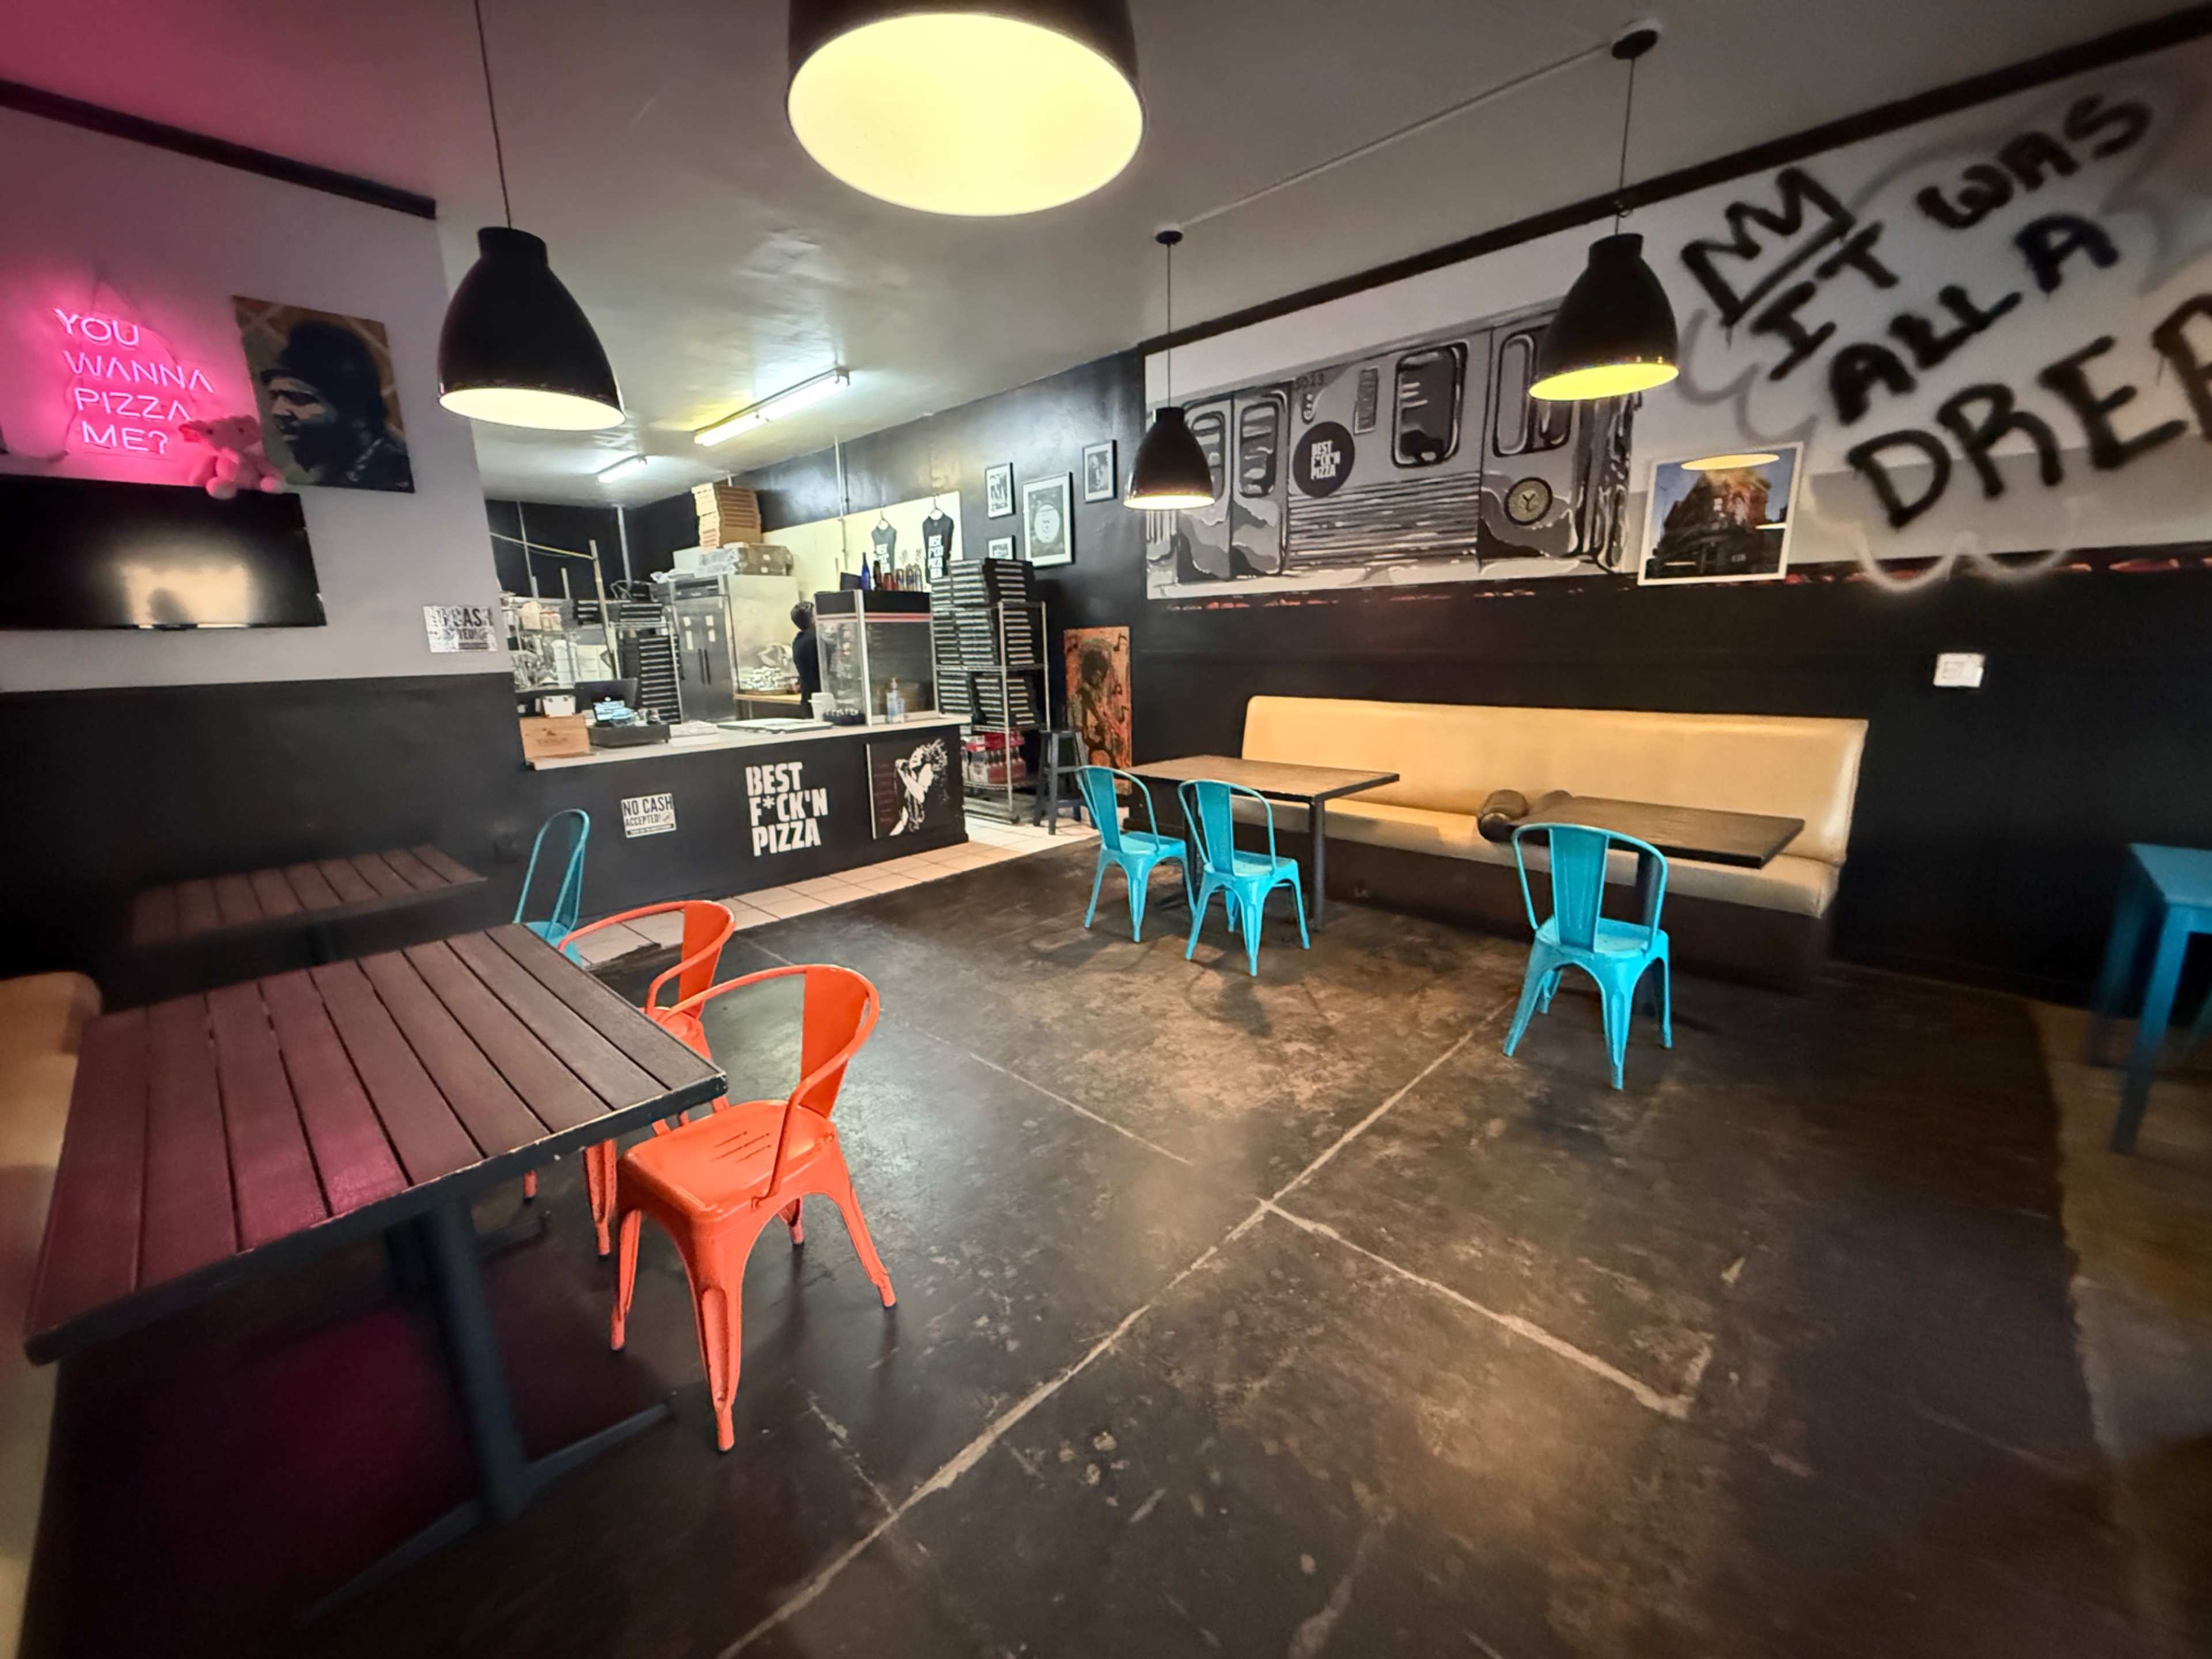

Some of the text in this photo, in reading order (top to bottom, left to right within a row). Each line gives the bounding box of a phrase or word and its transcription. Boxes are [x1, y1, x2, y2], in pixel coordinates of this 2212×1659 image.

[1750, 94, 2153, 381] IT WAS
[54, 308, 139, 346] YOU
[1828, 213, 2120, 425] ALL A
[62, 350, 214, 393] WANNA
[74, 387, 192, 421] PIZZA
[82, 420, 168, 454] ME?
[1522, 493, 1536, 512] Y
[745, 761, 803, 797] BEST
[623, 795, 673, 816] NO CASH
[625, 813, 662, 827] ACCEPTED!
[752, 817, 822, 857] PIZZA
